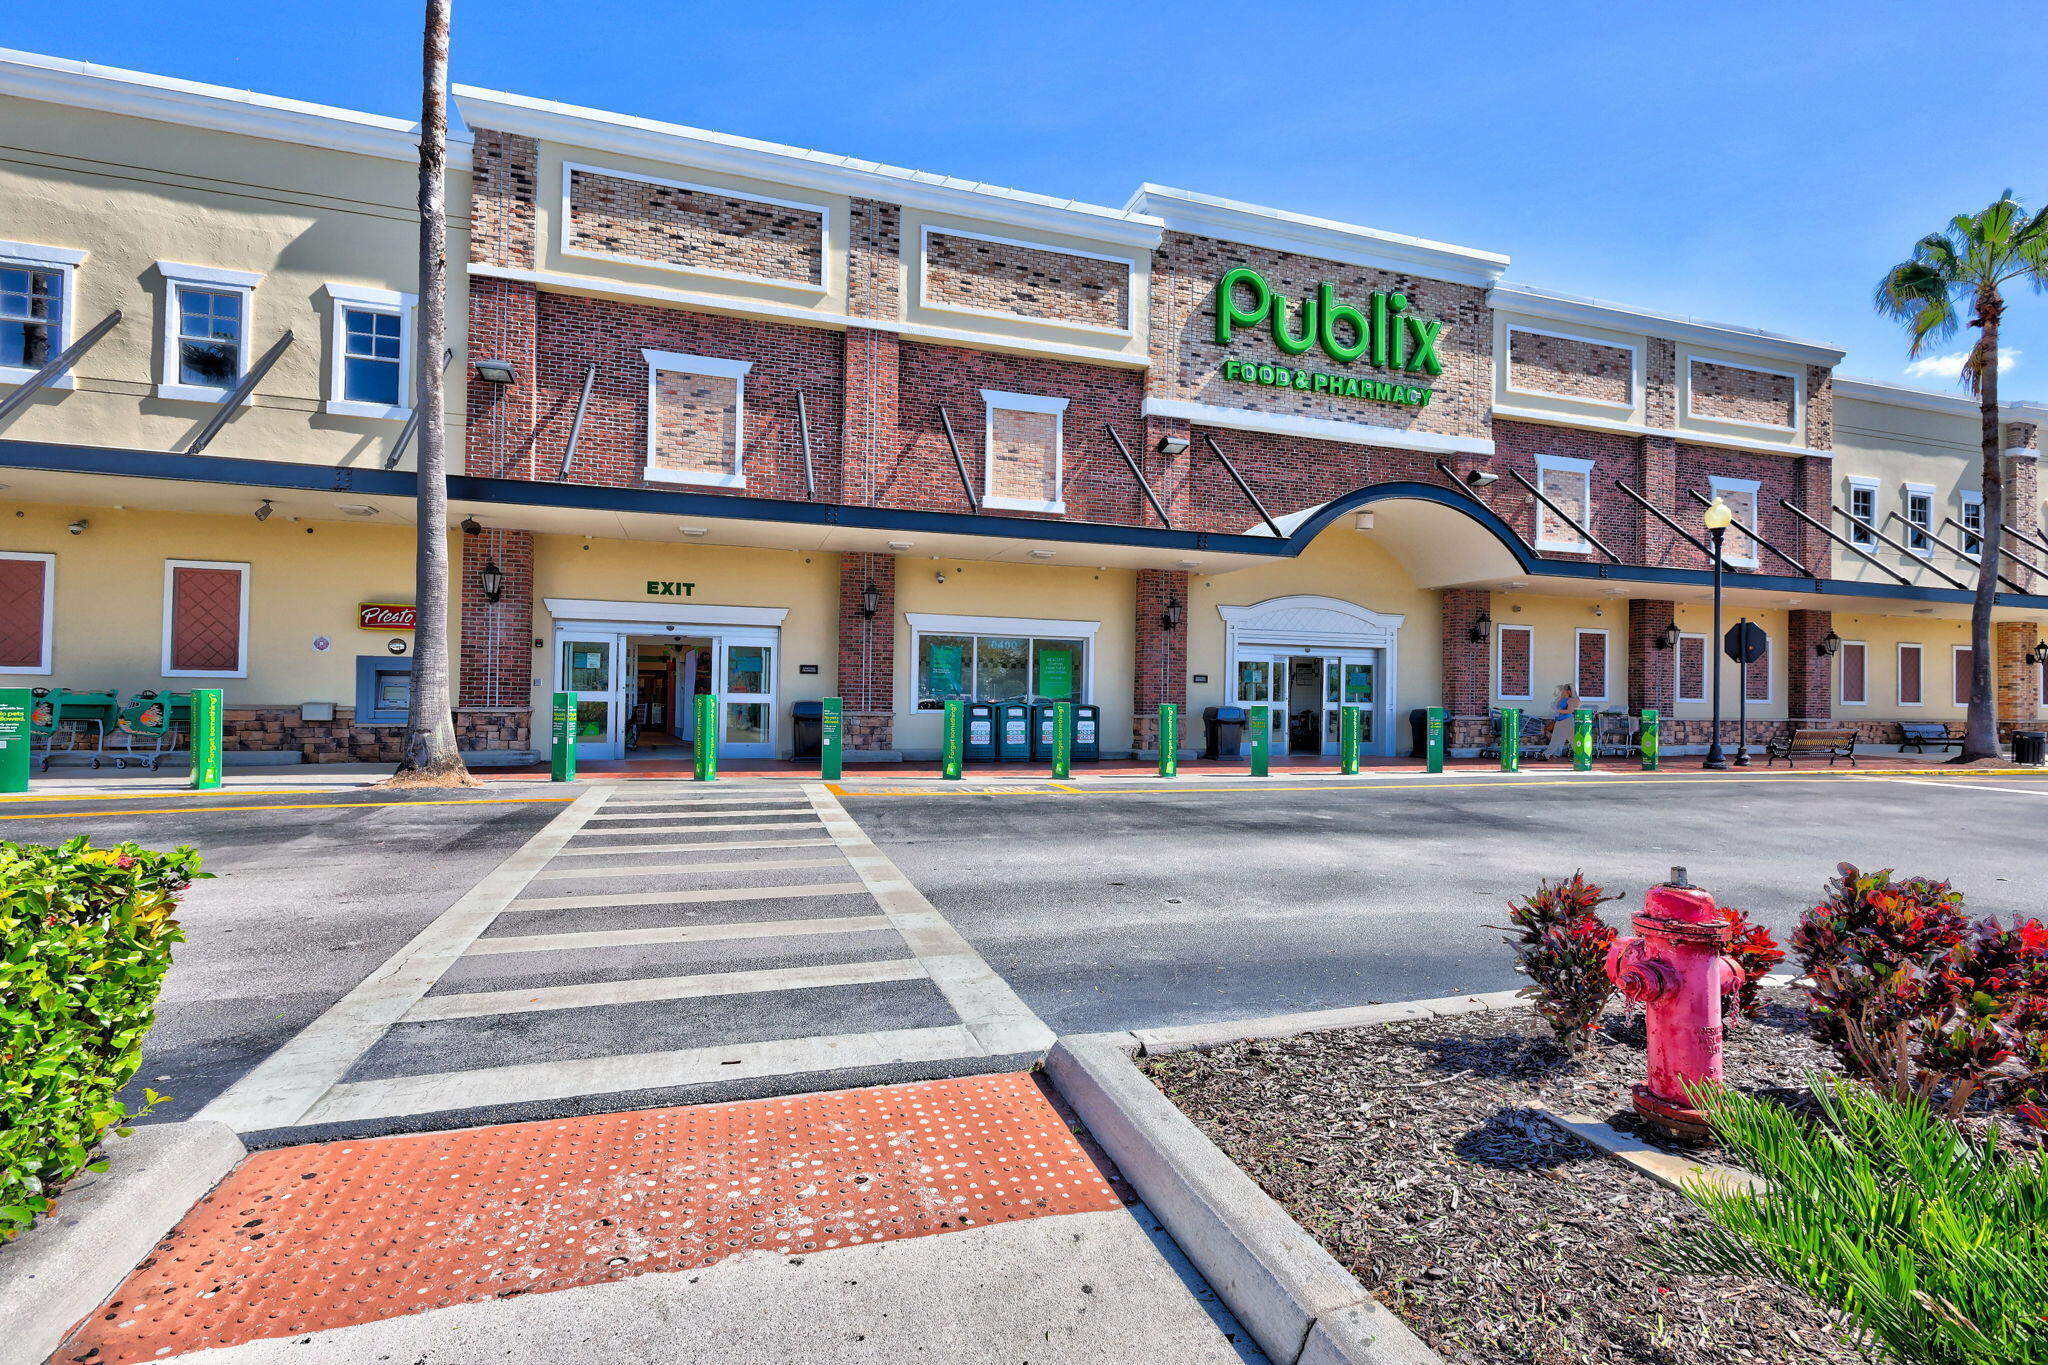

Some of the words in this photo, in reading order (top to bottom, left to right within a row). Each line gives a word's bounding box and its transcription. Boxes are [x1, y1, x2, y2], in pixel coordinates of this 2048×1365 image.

[1216, 266, 1443, 375] Publix
[1224, 360, 1292, 387] FOOD
[1292, 369, 1311, 391] &
[1311, 373, 1433, 407] PHARMACY
[647, 581, 695, 596] EXIT
[362, 608, 416, 625] Presto
[208, 693, 217, 737] something?
[949, 704, 957, 739] something?
[207, 737, 216, 763] Forget
[1056, 740, 1064, 759] Forget
